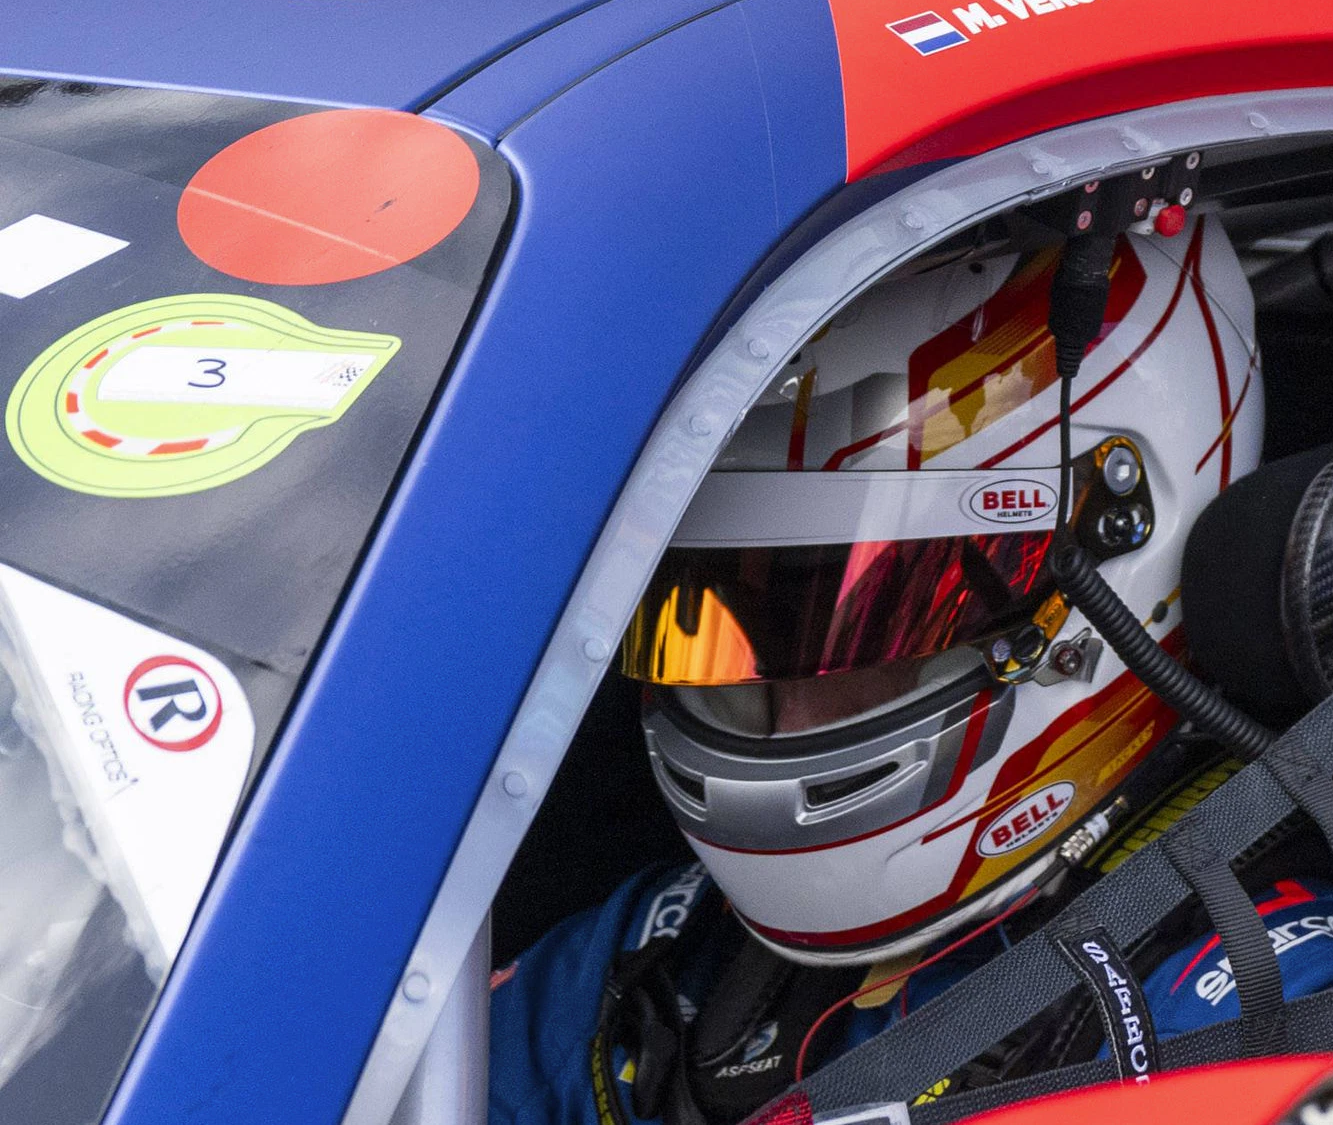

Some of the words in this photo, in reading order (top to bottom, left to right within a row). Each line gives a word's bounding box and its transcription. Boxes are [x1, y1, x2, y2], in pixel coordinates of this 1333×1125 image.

[952, 2, 1008, 35] M.
[186, 357, 227, 389] 3
[982, 488, 1047, 511] BELL
[997, 510, 1033, 518] HELMETS
[135, 678, 207, 733] R
[990, 793, 1065, 849] BELL
[1006, 811, 1059, 849] HELMETS
[1082, 940, 1150, 1085] SAFEC
